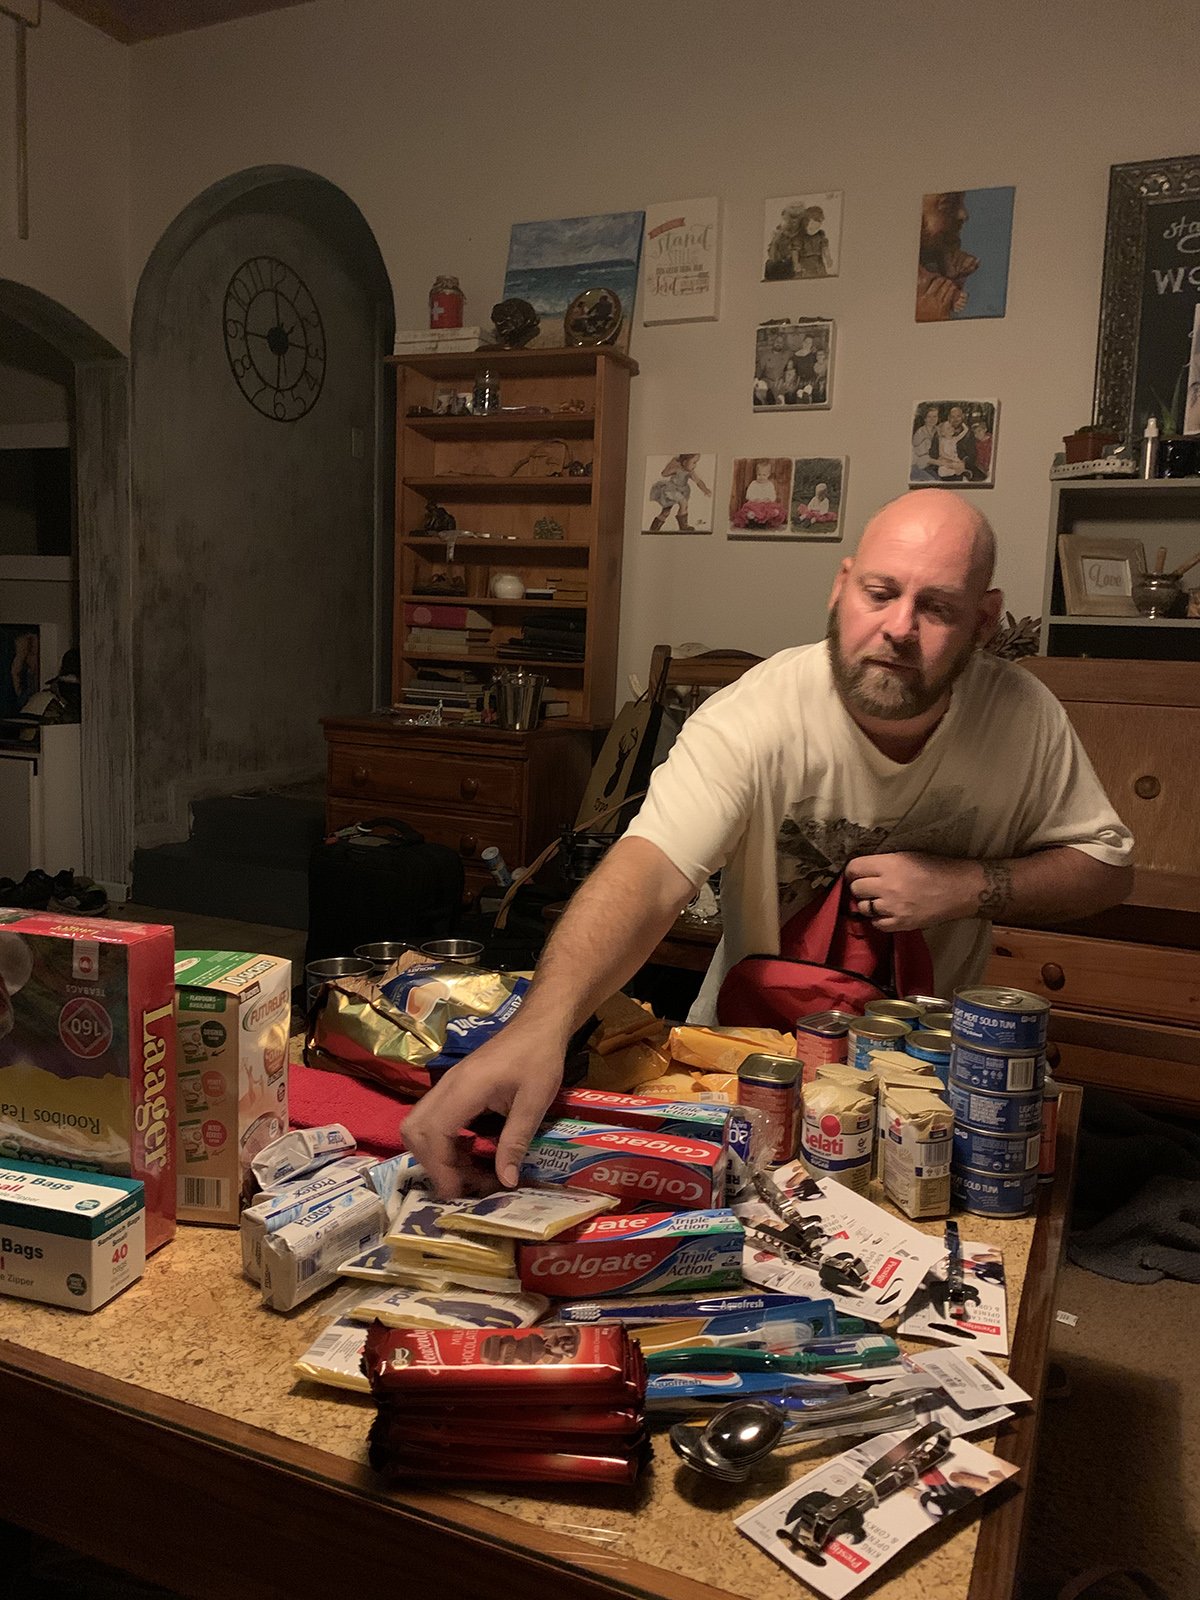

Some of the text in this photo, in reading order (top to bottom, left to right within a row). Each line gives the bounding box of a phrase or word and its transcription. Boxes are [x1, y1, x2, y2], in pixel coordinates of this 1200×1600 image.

[65, 984, 105, 998] TEABAGS
[249, 989, 288, 1026] FUTURELIFE
[71, 1017, 102, 1037] 160
[979, 1016, 999, 1028] SOLID
[999, 1019, 1017, 1030] TUNA
[135, 998, 174, 1169] Laager
[563, 1090, 648, 1106] olgate
[1, 1103, 101, 1135] Rooibos Tea
[540, 1147, 580, 1162] Action
[600, 1133, 711, 1158] Colgate
[536, 1156, 569, 1173] Triple
[810, 1157, 830, 1169] SUGAR
[0, 1172, 74, 1191] ich Bags
[0, 1183, 24, 1193] all
[292, 1177, 338, 1199] Protex
[592, 1166, 704, 1201] Colgate
[963, 1179, 981, 1190] SOLID
[981, 1184, 999, 1194] TUNA
[293, 1203, 336, 1226] Protex
[674, 1215, 709, 1226] Triple
[583, 1217, 649, 1234] gate
[667, 1221, 710, 1231] Action
[97, 1225, 126, 1247] Sandwich
[2, 1237, 44, 1260] Bags
[112, 1243, 128, 1264] 40
[676, 1249, 718, 1265] Triple
[530, 1252, 652, 1280] Colgate
[666, 1262, 713, 1276] Action
[875, 1260, 898, 1286] Prestige
[7, 1273, 35, 1286] Zipper
[719, 1298, 765, 1311] Aquafresh
[461, 1329, 478, 1367] HOCOLATE
[829, 1541, 863, 1568] Prestig
